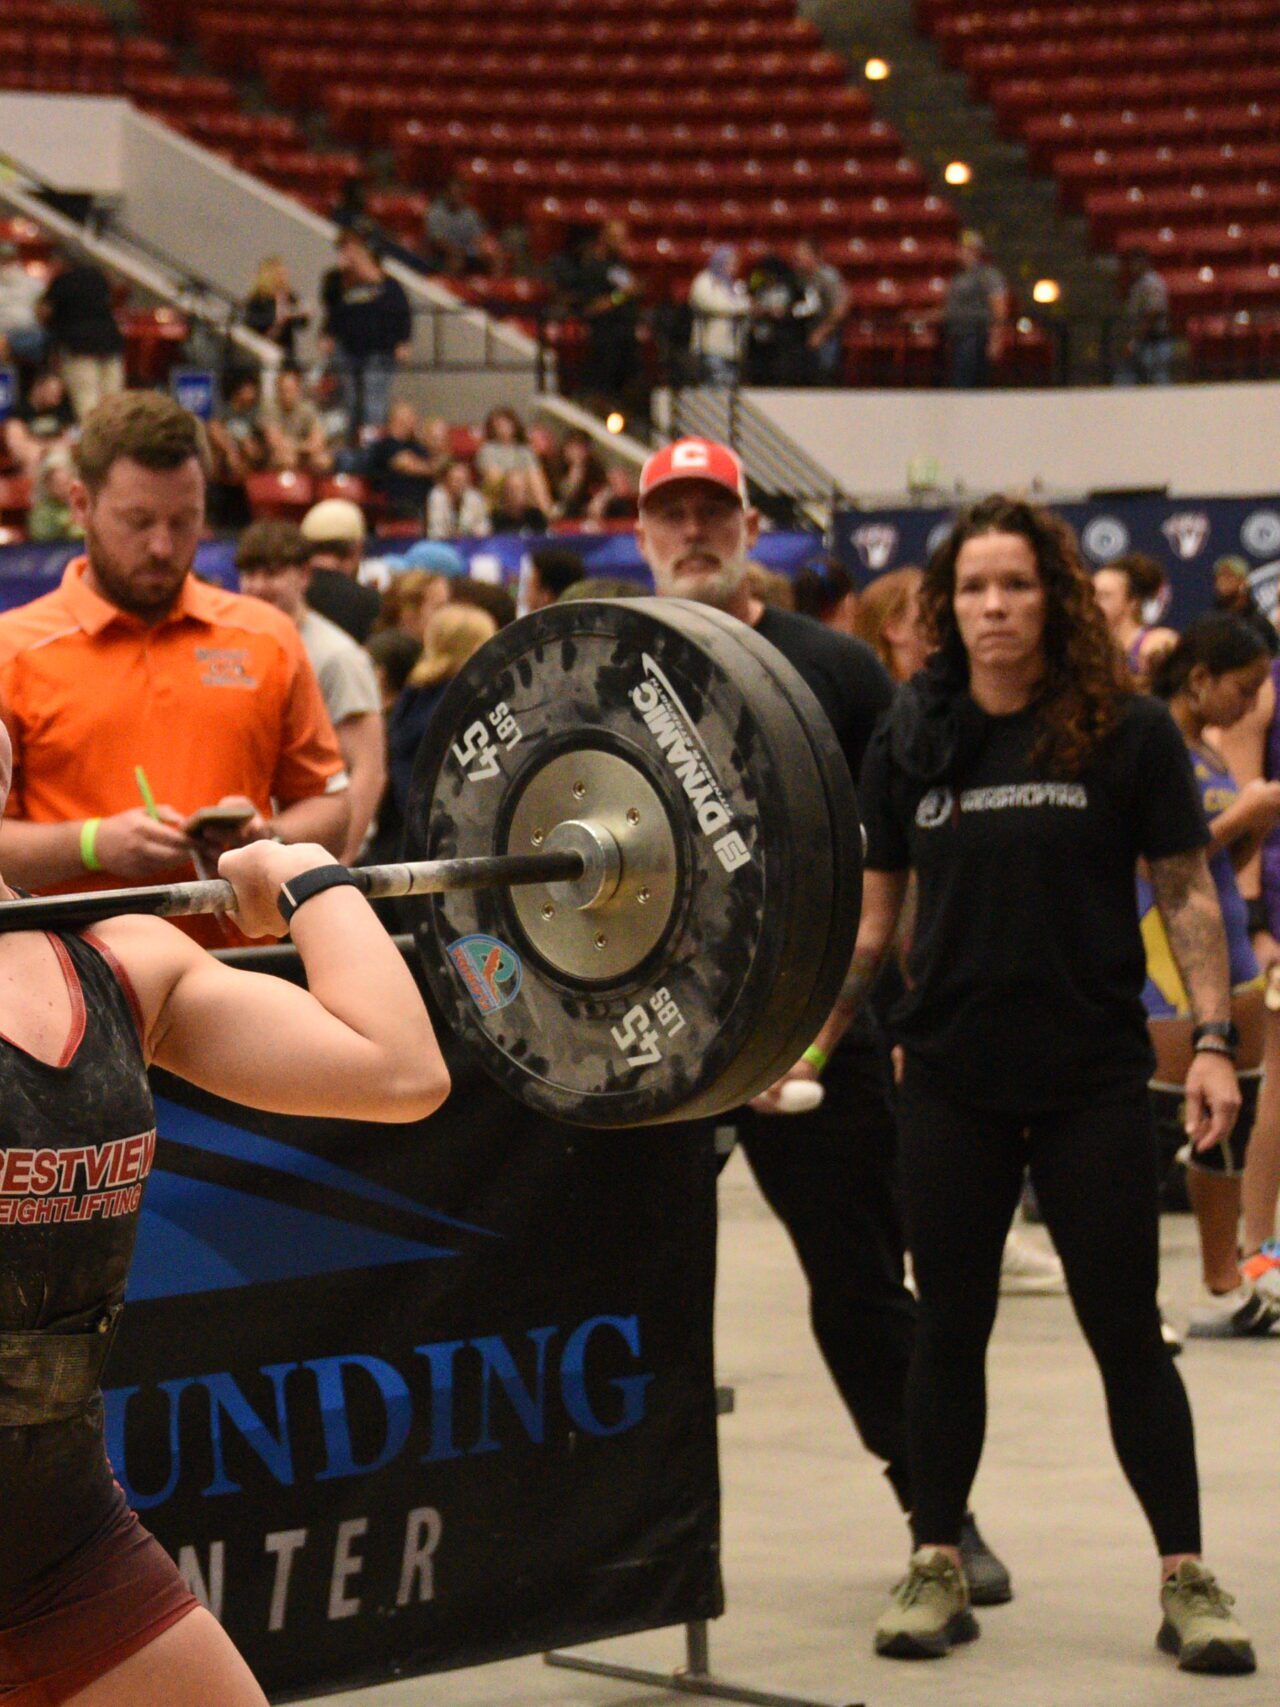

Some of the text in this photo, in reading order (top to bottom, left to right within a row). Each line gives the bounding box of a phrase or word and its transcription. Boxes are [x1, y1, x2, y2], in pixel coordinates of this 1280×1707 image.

[671, 442, 708, 468] C
[452, 720, 500, 782] 45
[489, 702, 522, 751] LBS
[632, 682, 731, 836] DYNAMIC
[610, 1004, 662, 1067] 45
[649, 986, 686, 1037] LBS
[100, 1314, 655, 1511] UNDING
[176, 1506, 444, 1634] NTER
